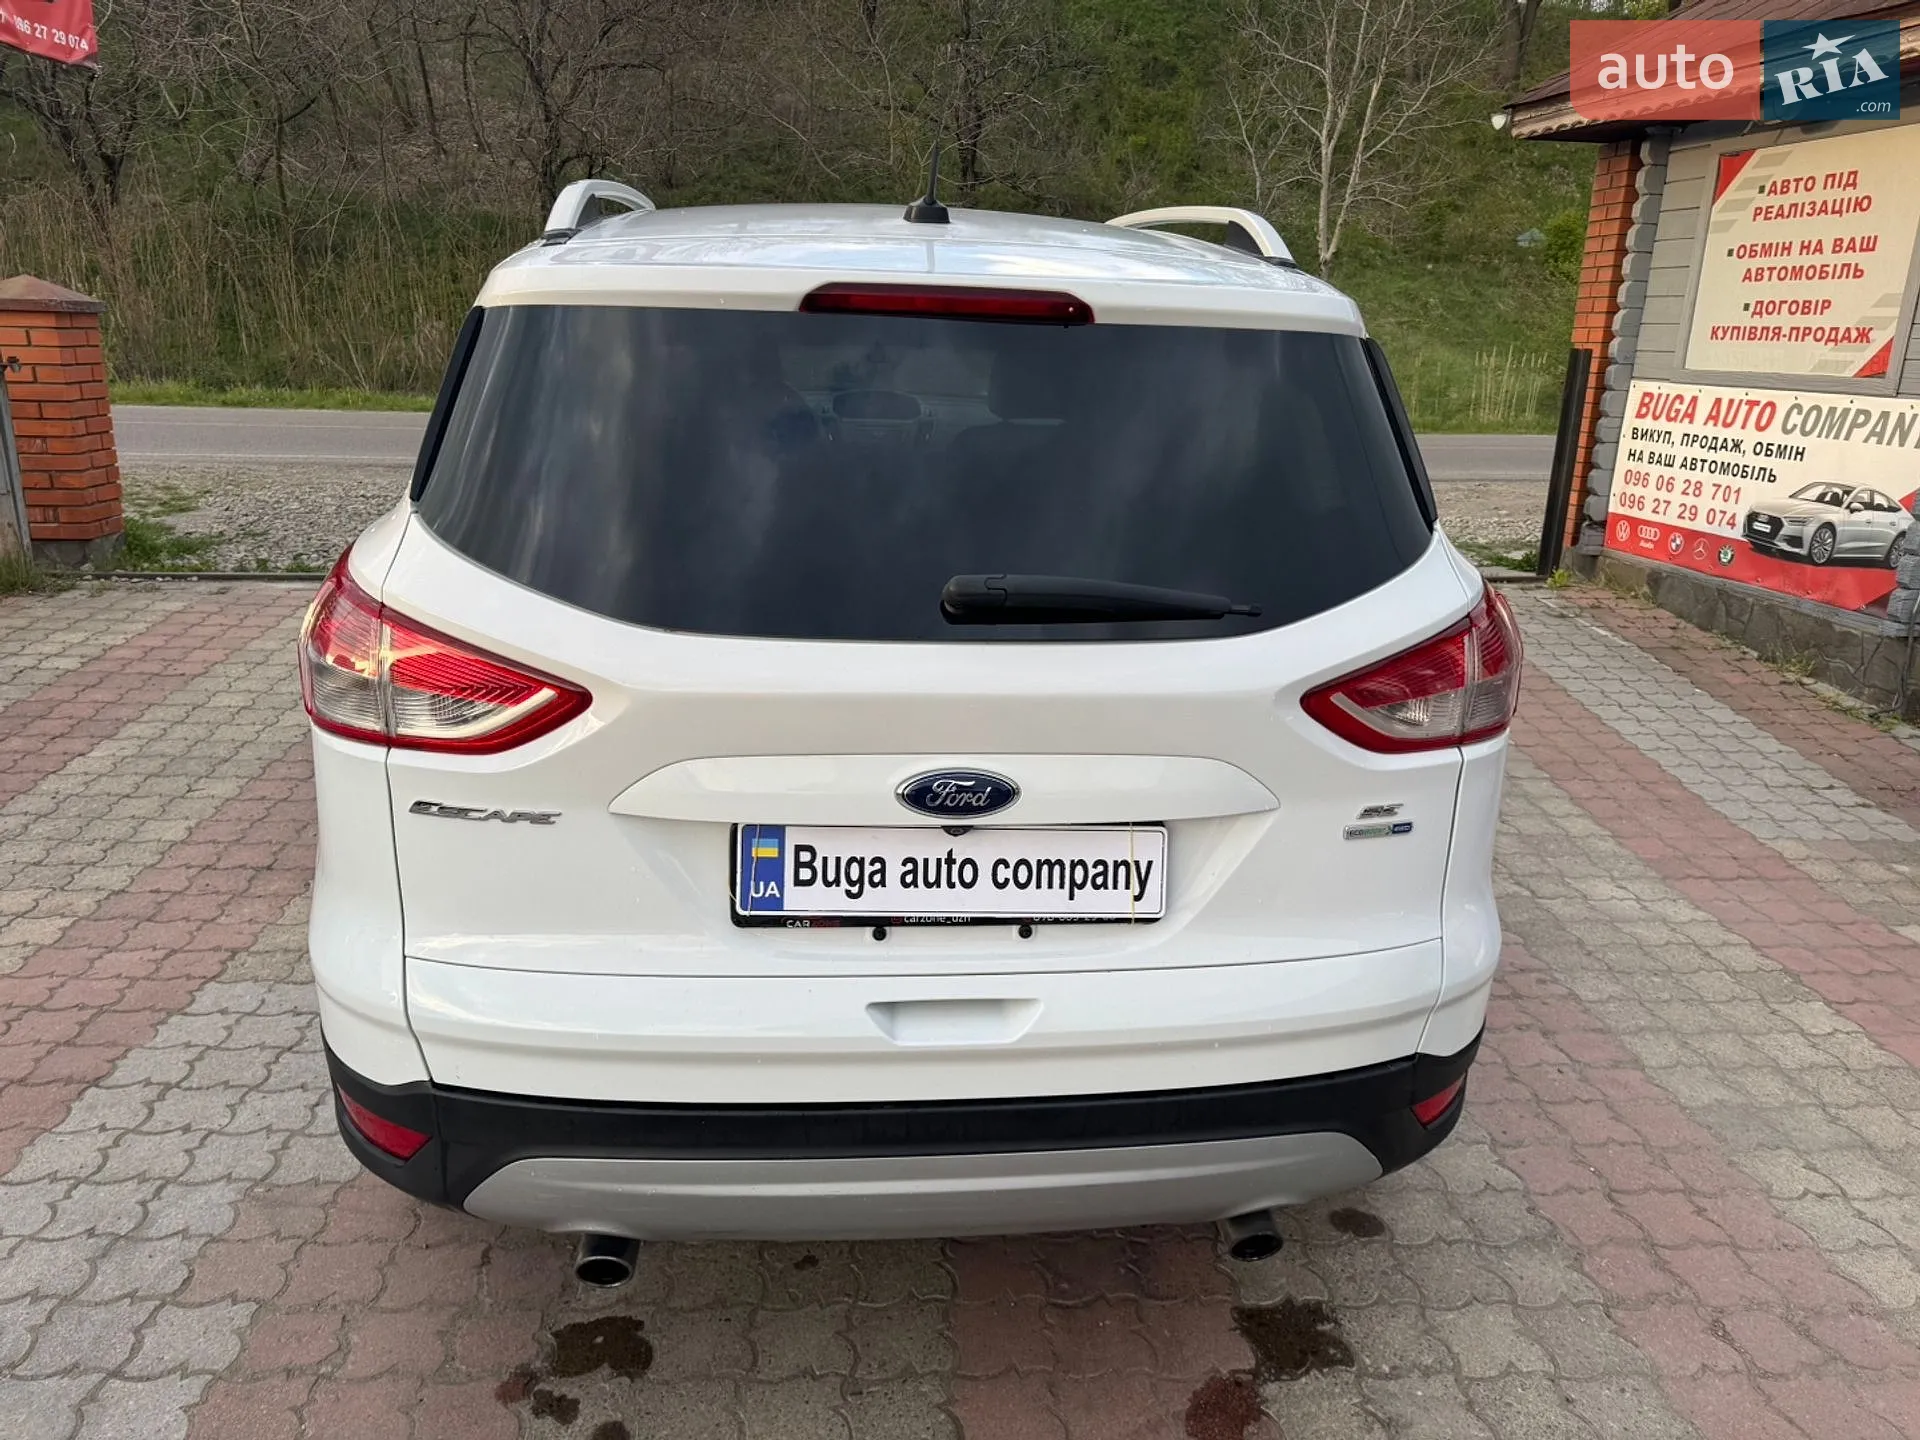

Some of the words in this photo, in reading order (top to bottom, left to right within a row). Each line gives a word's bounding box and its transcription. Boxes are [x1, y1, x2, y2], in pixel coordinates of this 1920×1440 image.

[33, 23, 47, 40] 27
[52, 29, 66, 45] 29
[68, 34, 89, 51] 074
[1766, 175, 1816, 197] АВТО
[1822, 170, 1859, 192] ПІД
[1752, 195, 1873, 222] РЕАЛІЗАЦІЮ
[1736, 240, 1794, 260] ОБМІН
[1799, 239, 1824, 256] НА
[1831, 235, 1879, 255] ВАШ
[1742, 263, 1866, 283] АВТОМОБІЛЬ
[1751, 299, 1832, 318] ДОГОВІР
[1710, 325, 1874, 346] КУПІВЛЯ-ПРОДАЖ
[1634, 391, 1699, 425] BUGA
[1703, 395, 1777, 433] AUTO
[1631, 427, 1676, 448] ВИКУП,
[1680, 432, 1747, 458] ПРОДАЖ,
[1752, 441, 1807, 462] ОБМІН
[1627, 448, 1645, 464] НА
[1647, 451, 1676, 468] ВАШ
[1679, 458, 1778, 483] АВТОМОБІЛЬ
[1623, 469, 1651, 489] 096
[1655, 474, 1676, 493] 06
[1680, 479, 1703, 498] 28
[1711, 483, 1742, 505] 701
[1618, 491, 1646, 511] 096
[1651, 498, 1672, 516] 27
[1676, 503, 1699, 522] 29
[1705, 508, 1738, 530] 074
[925, 779, 992, 807] Ford
[793, 844, 887, 900] Buga
[900, 848, 979, 890] auto
[991, 857, 1154, 902] company
[750, 881, 781, 898] UA
